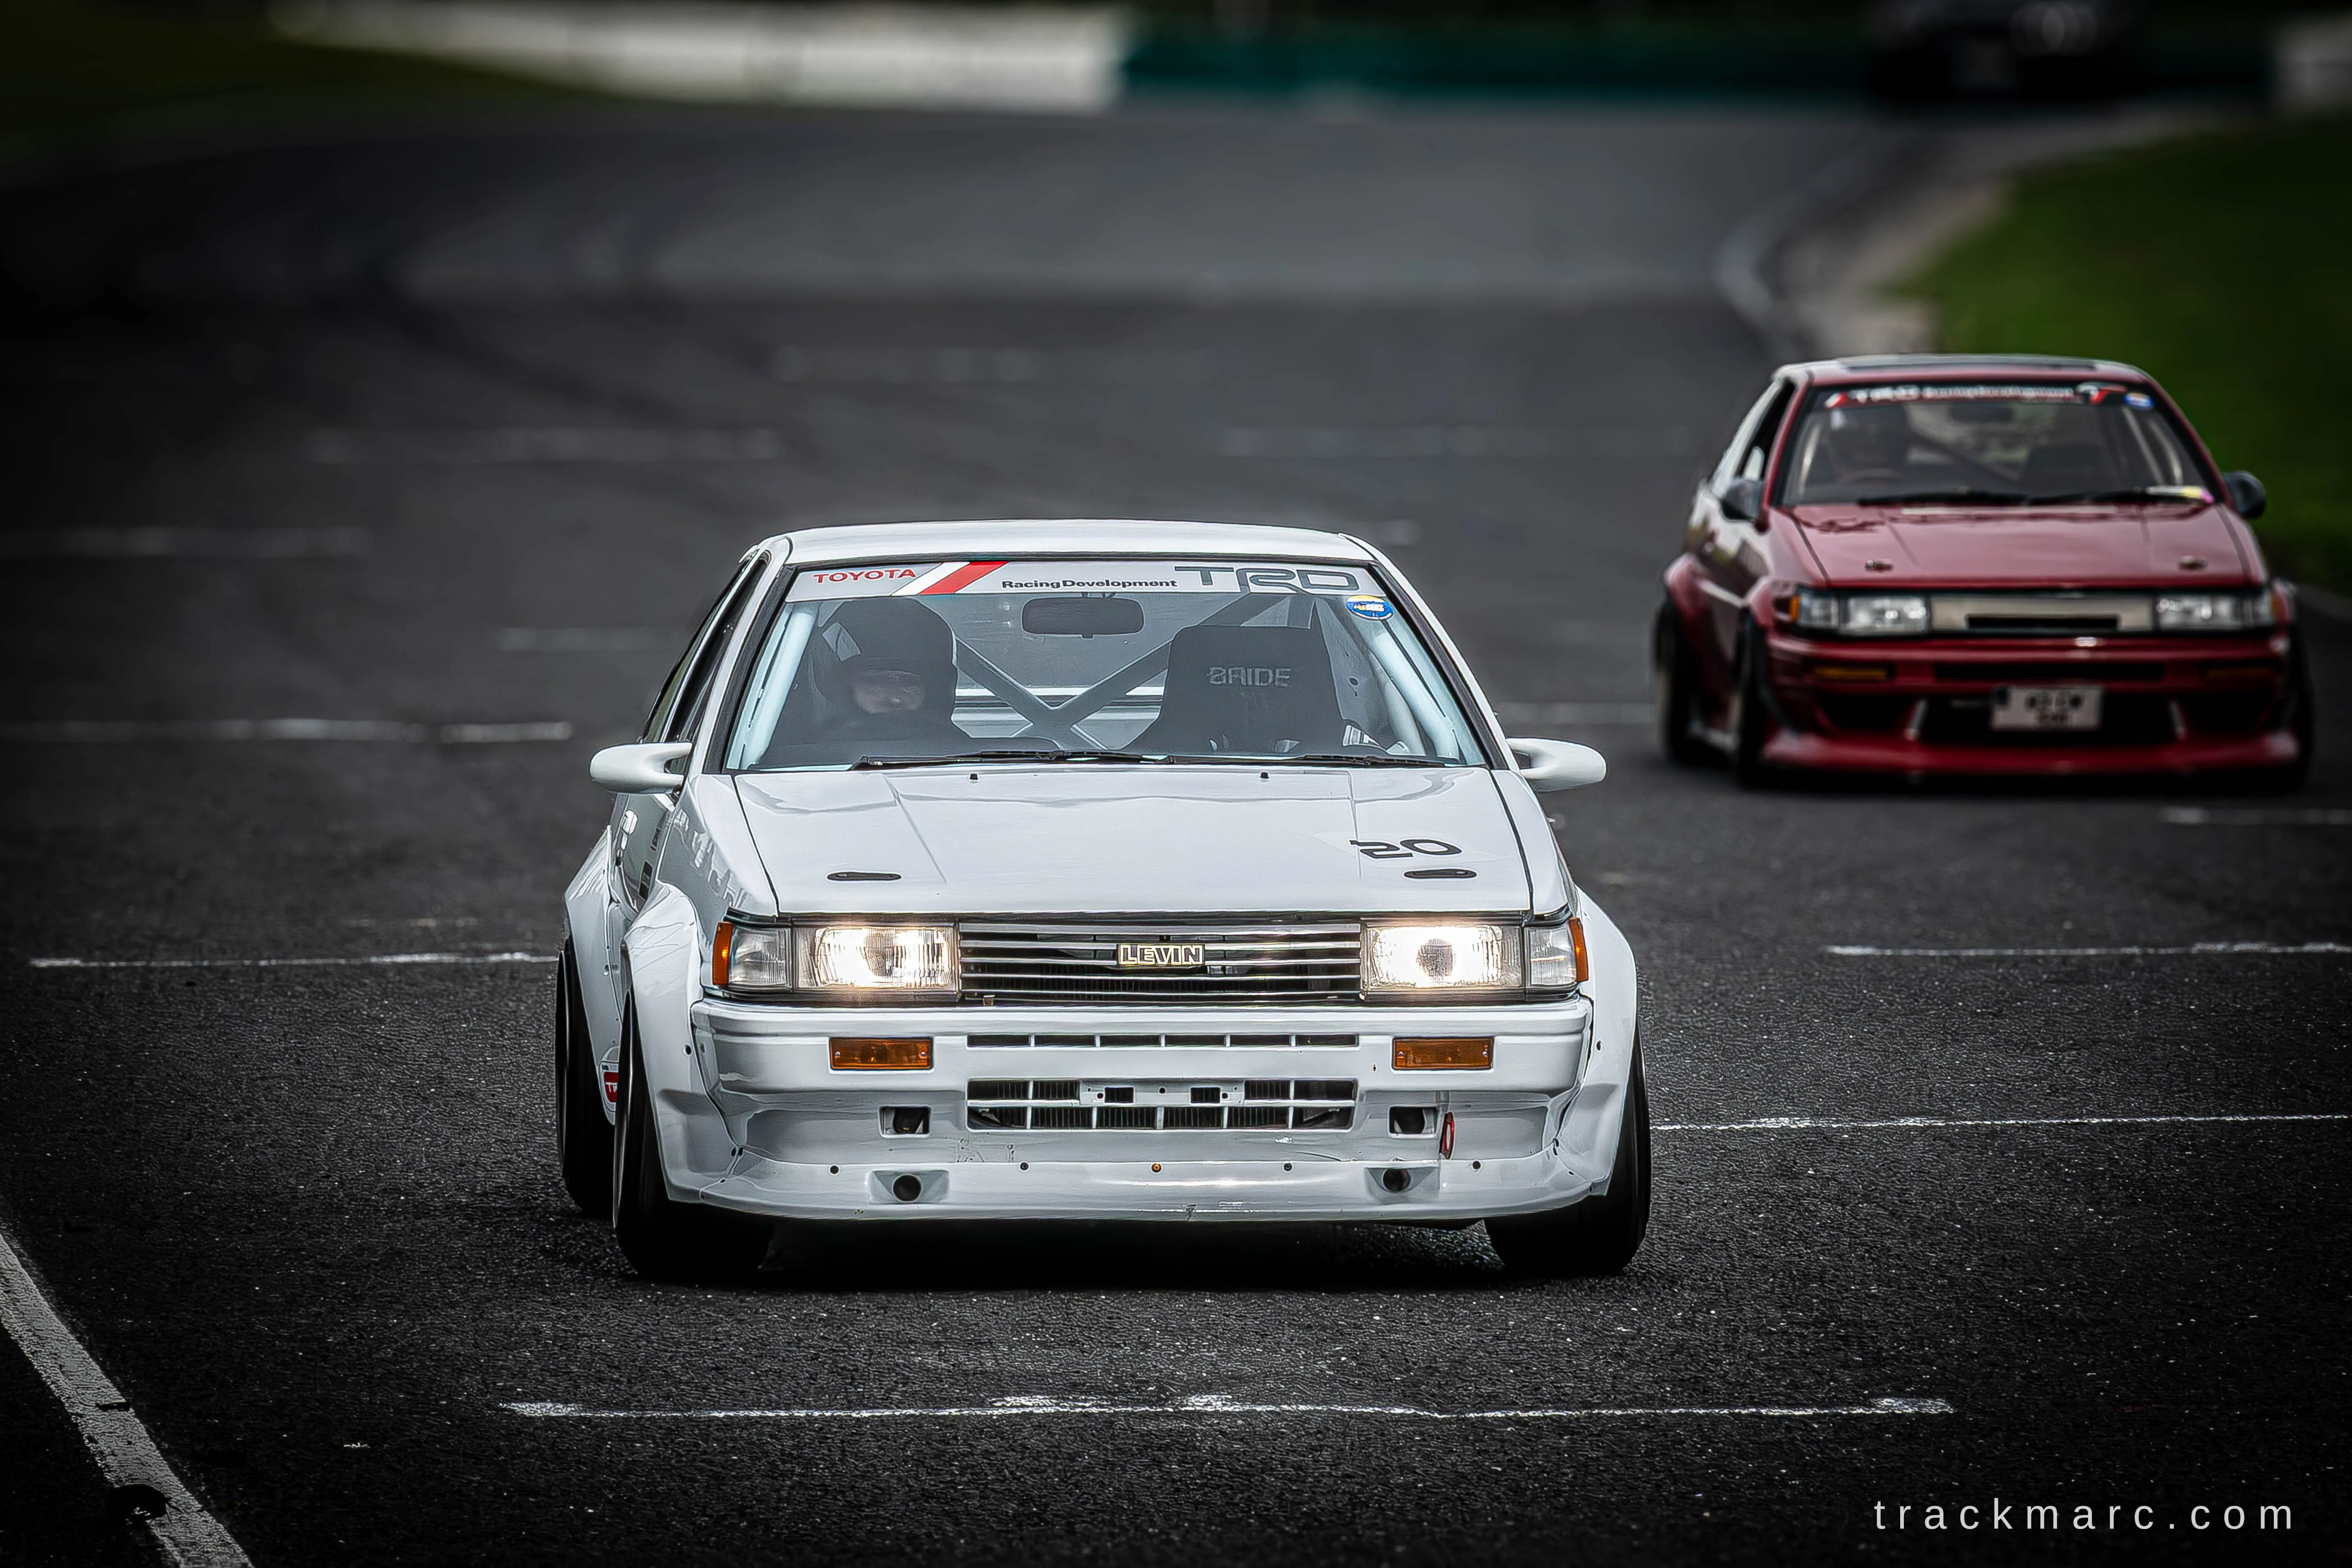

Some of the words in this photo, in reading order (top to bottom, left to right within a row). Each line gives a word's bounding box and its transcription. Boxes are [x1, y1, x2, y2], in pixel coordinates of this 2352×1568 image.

[813, 569, 916, 583] TOYOTA
[1001, 580, 1060, 589] Racing
[1062, 579, 1177, 588] Development
[1175, 566, 1359, 593] TRD
[1207, 667, 1291, 687] BRIDE
[1349, 839, 1462, 859] 20
[1120, 944, 1202, 965] LEVIN
